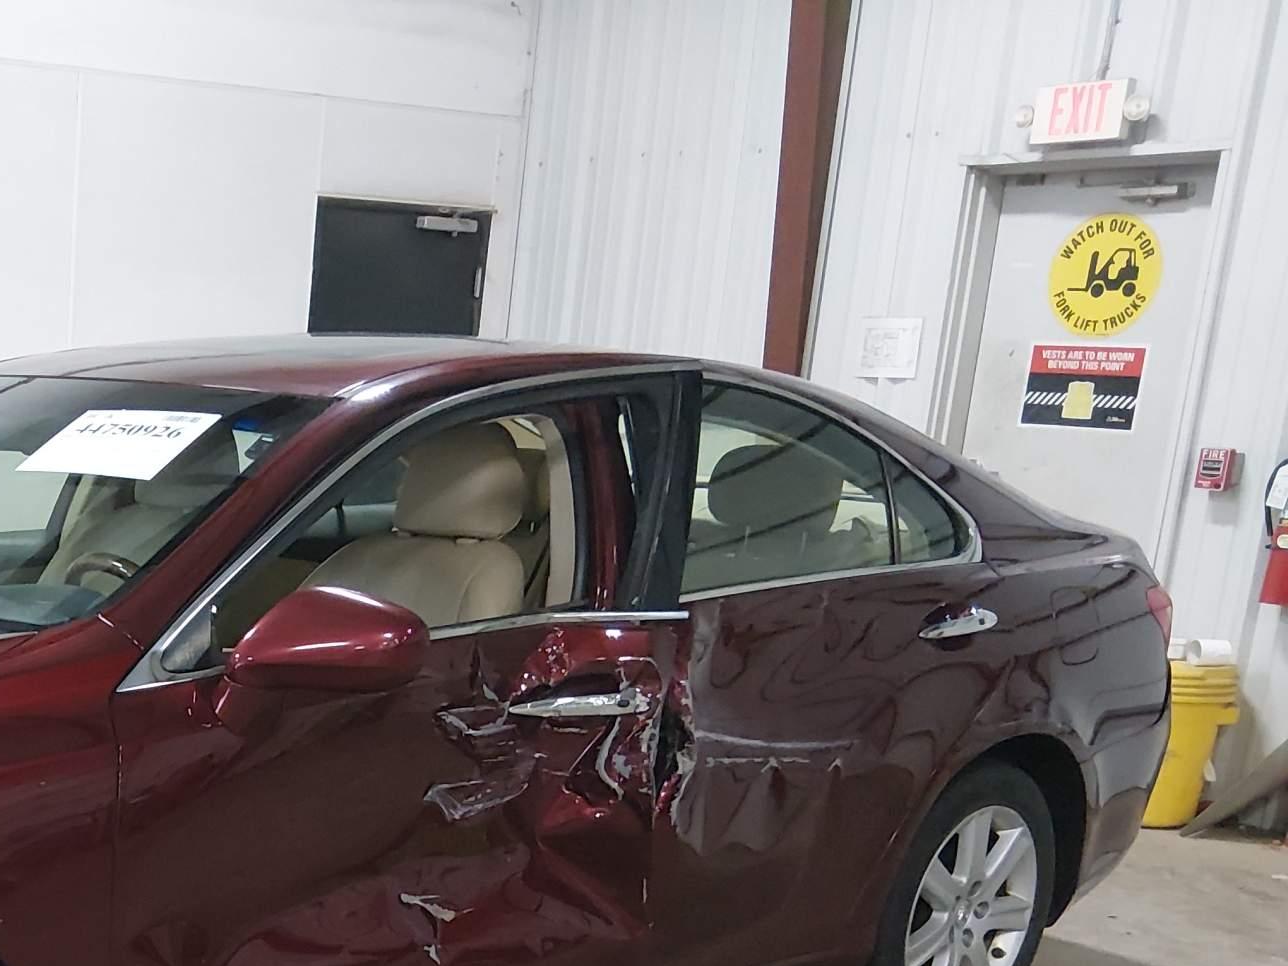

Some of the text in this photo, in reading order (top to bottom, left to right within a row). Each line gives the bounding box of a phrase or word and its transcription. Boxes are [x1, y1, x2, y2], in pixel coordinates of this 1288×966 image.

[1048, 83, 1113, 136] EXIT
[1060, 218, 1155, 260] WATCH OUT FOR
[1053, 291, 1147, 332] FORK LIFT TRUCKS
[1042, 349, 1136, 363] VESTS ARE TO BE WORN
[1047, 360, 1126, 372] BEYOND THIS POINT
[76, 423, 185, 440] 44750926
[1202, 448, 1226, 460] FIRE
